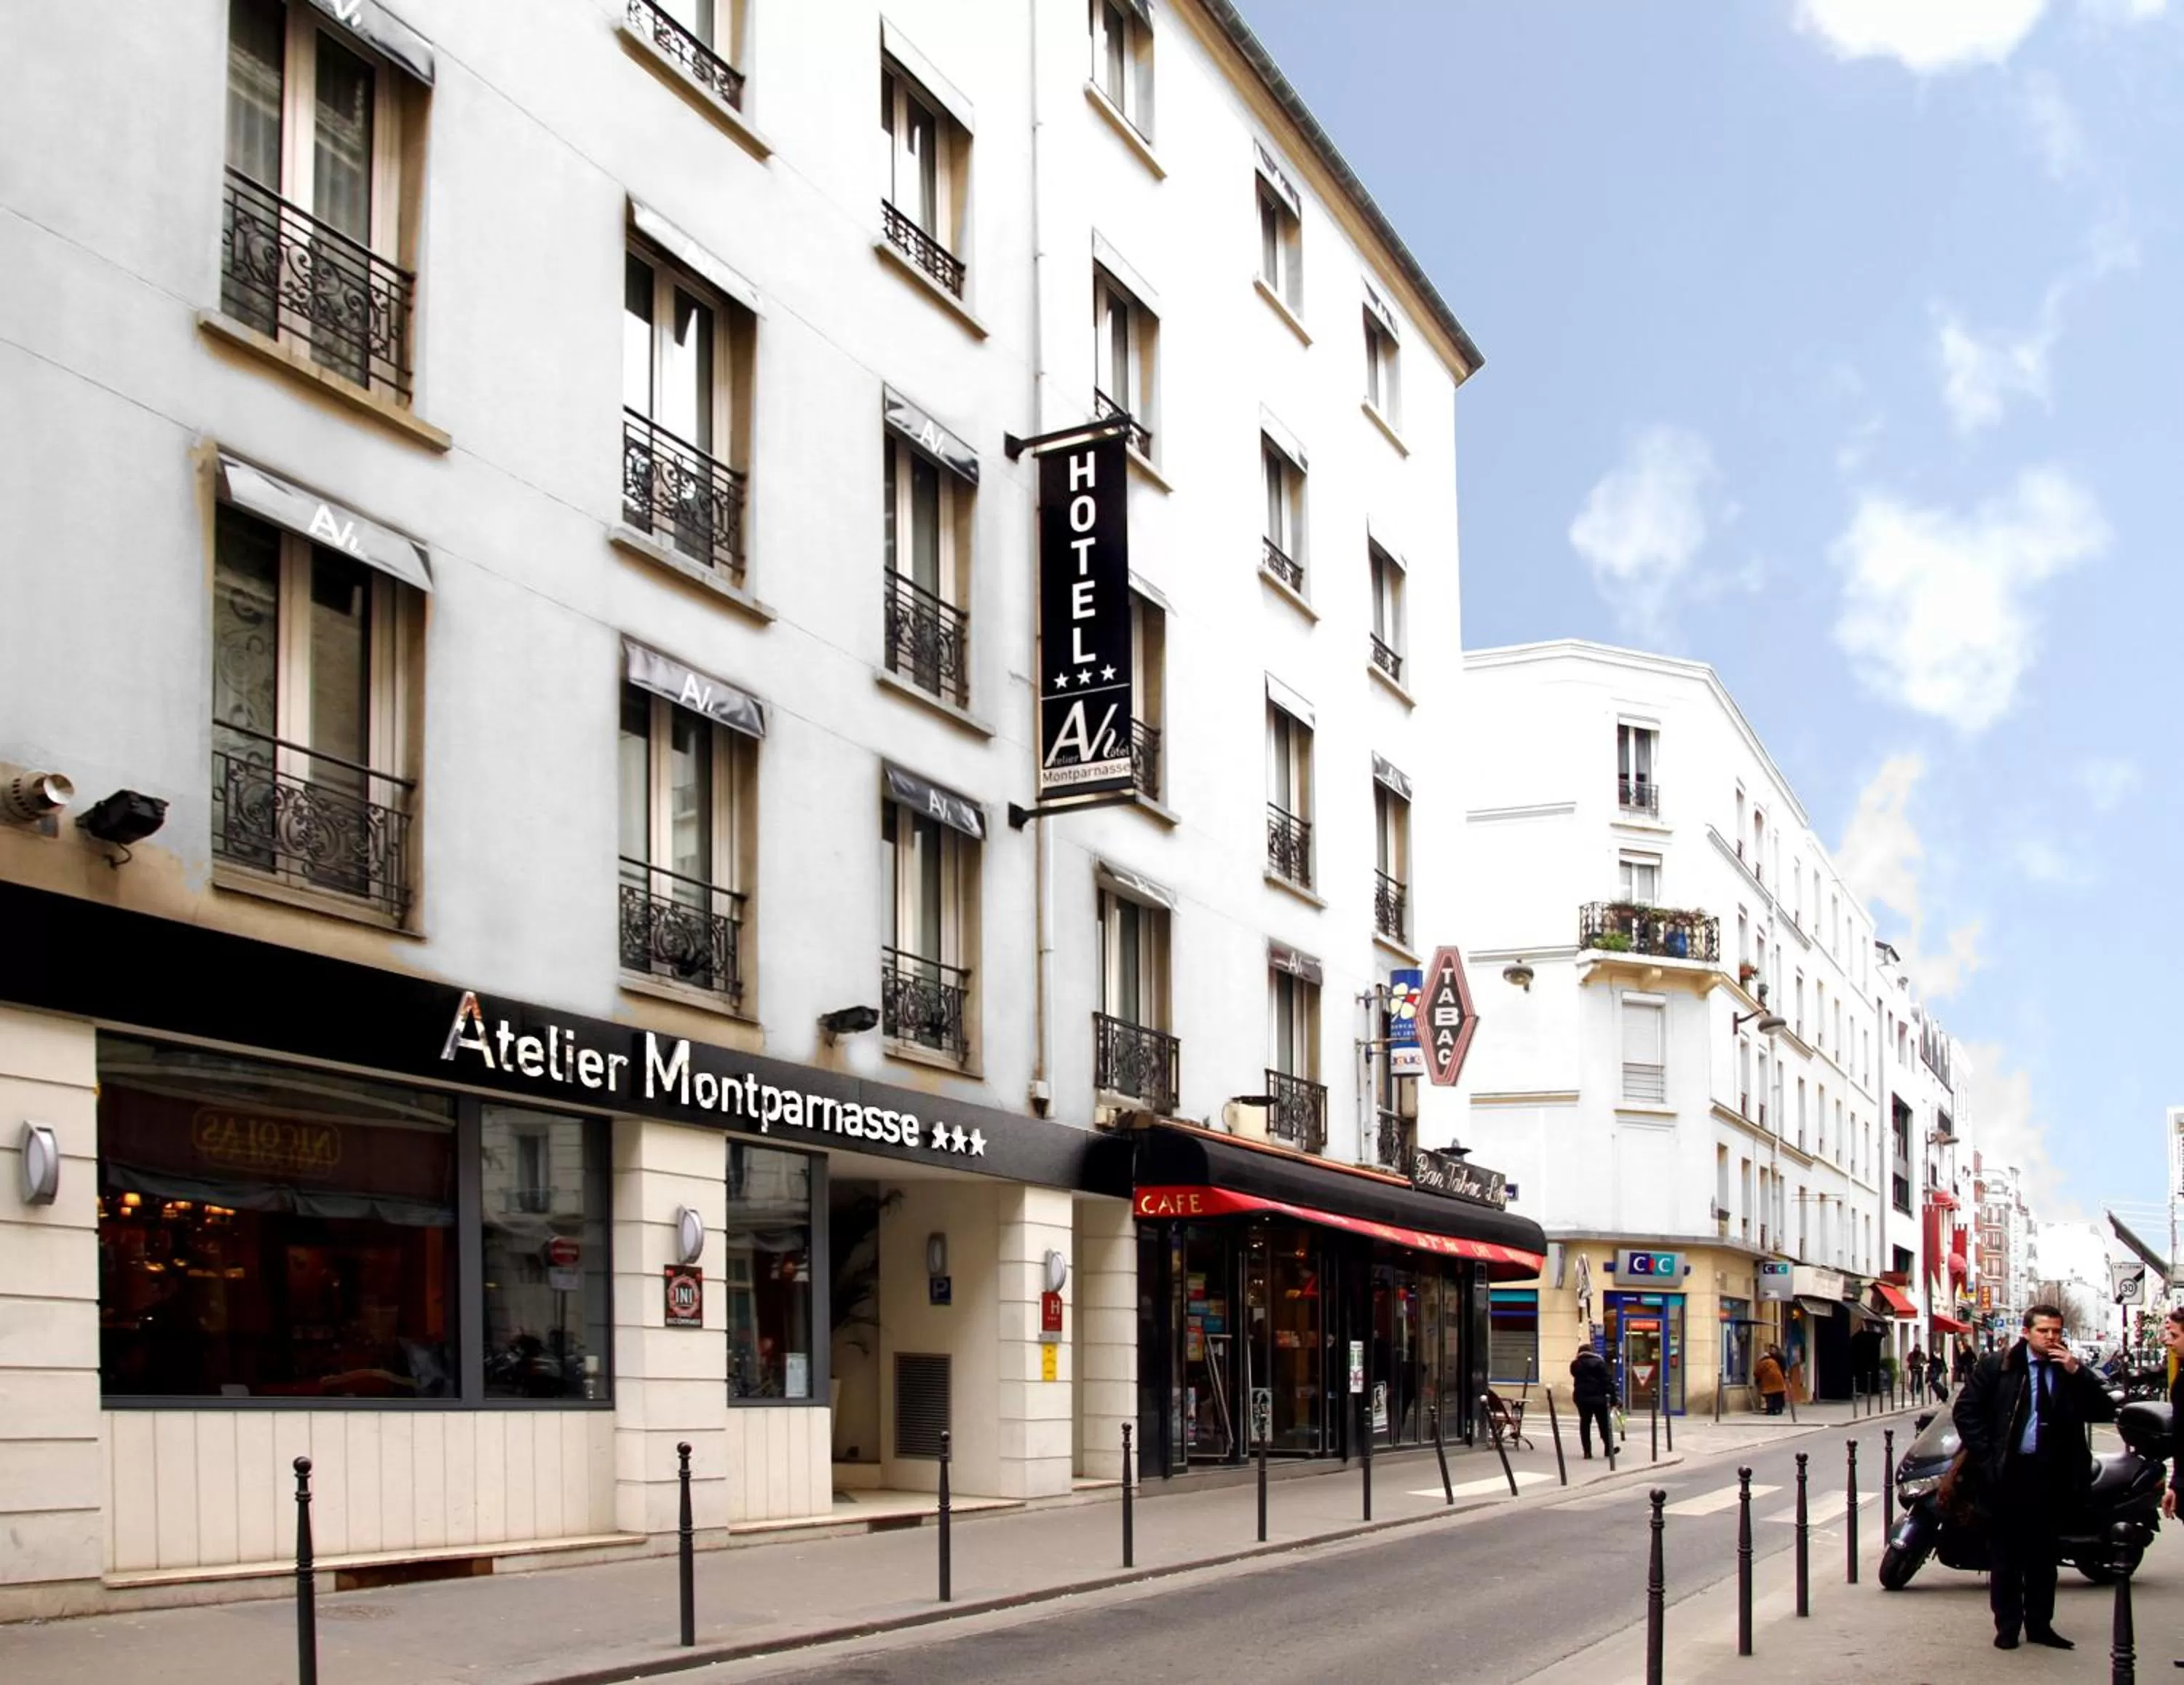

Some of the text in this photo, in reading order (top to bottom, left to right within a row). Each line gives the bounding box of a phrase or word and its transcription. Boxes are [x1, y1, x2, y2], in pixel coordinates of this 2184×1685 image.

[1069, 450, 1096, 665] HOTEL
[1042, 763, 1131, 783] Montparnasse
[1435, 968, 1460, 1065] TABAC
[440, 991, 920, 1147] Atelier Montparnasse
[1141, 1193, 1203, 1215] CAFE
[1633, 1256, 1672, 1272] CIC
[933, 1279, 949, 1298] P
[2122, 1284, 2134, 1293] 30
[1051, 1299, 1061, 1314] H
